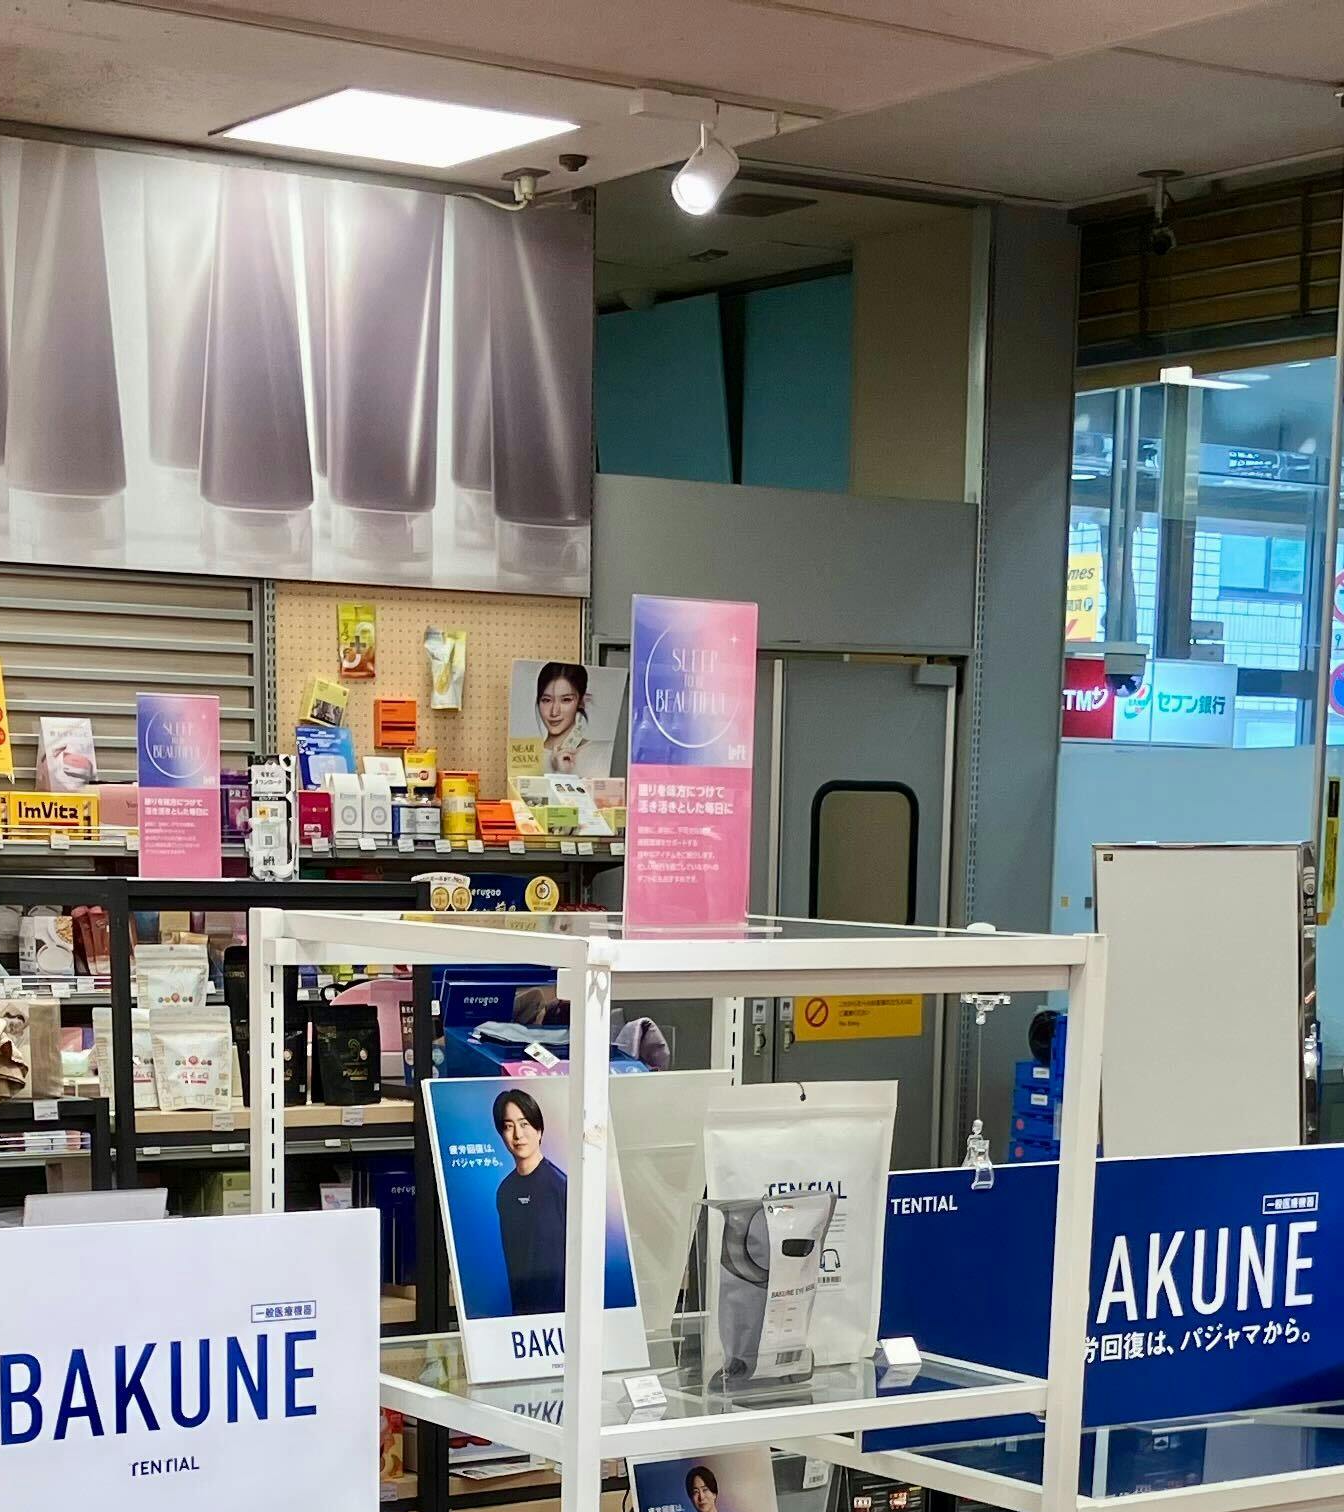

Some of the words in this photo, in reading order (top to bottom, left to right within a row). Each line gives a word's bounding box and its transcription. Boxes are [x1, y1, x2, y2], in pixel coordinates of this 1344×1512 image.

[470, 888, 502, 899] erugoo
[463, 996, 499, 1007] nerugoo
[890, 1195, 958, 1215] TENTIAL
[1095, 1220, 1317, 1324] AKUNE
[510, 1327, 565, 1360] BAK
[1083, 1317, 1311, 1363] 労回復は、パジャマから。
[0, 1329, 318, 1446] BAKUNE
[130, 1456, 201, 1478] TENTIAL
